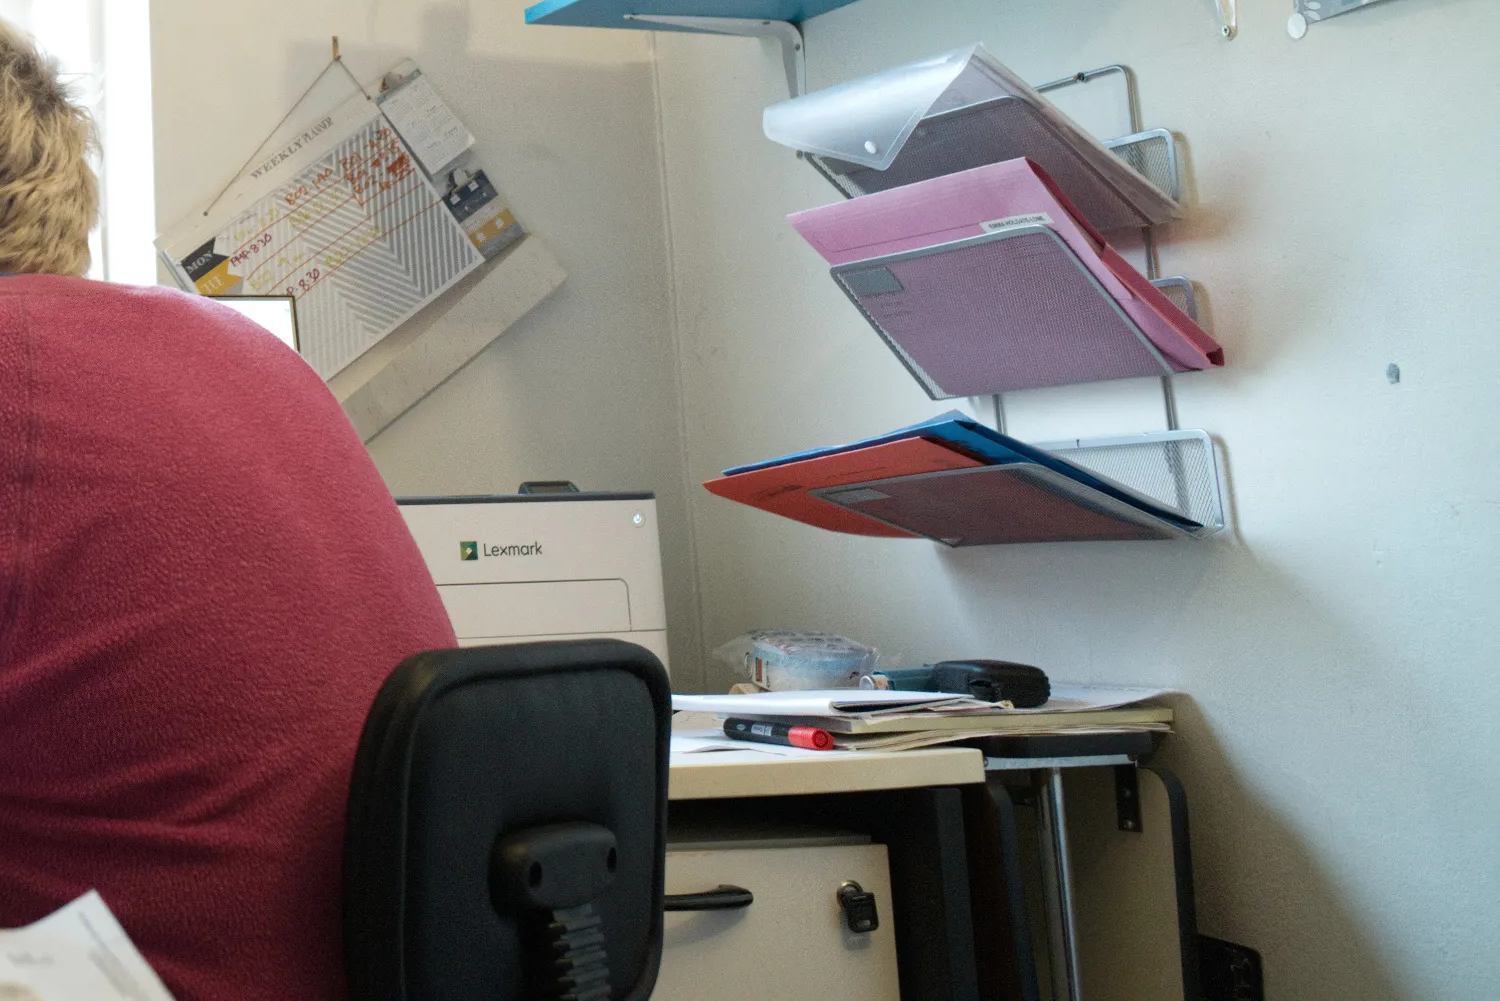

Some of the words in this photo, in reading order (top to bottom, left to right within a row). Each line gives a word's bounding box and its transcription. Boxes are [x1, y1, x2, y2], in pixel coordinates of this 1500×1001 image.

[250, 138, 304, 179] WEEKLY
[302, 116, 334, 144] PLANNER
[185, 250, 215, 274] MON
[483, 541, 543, 557] Lexmark
